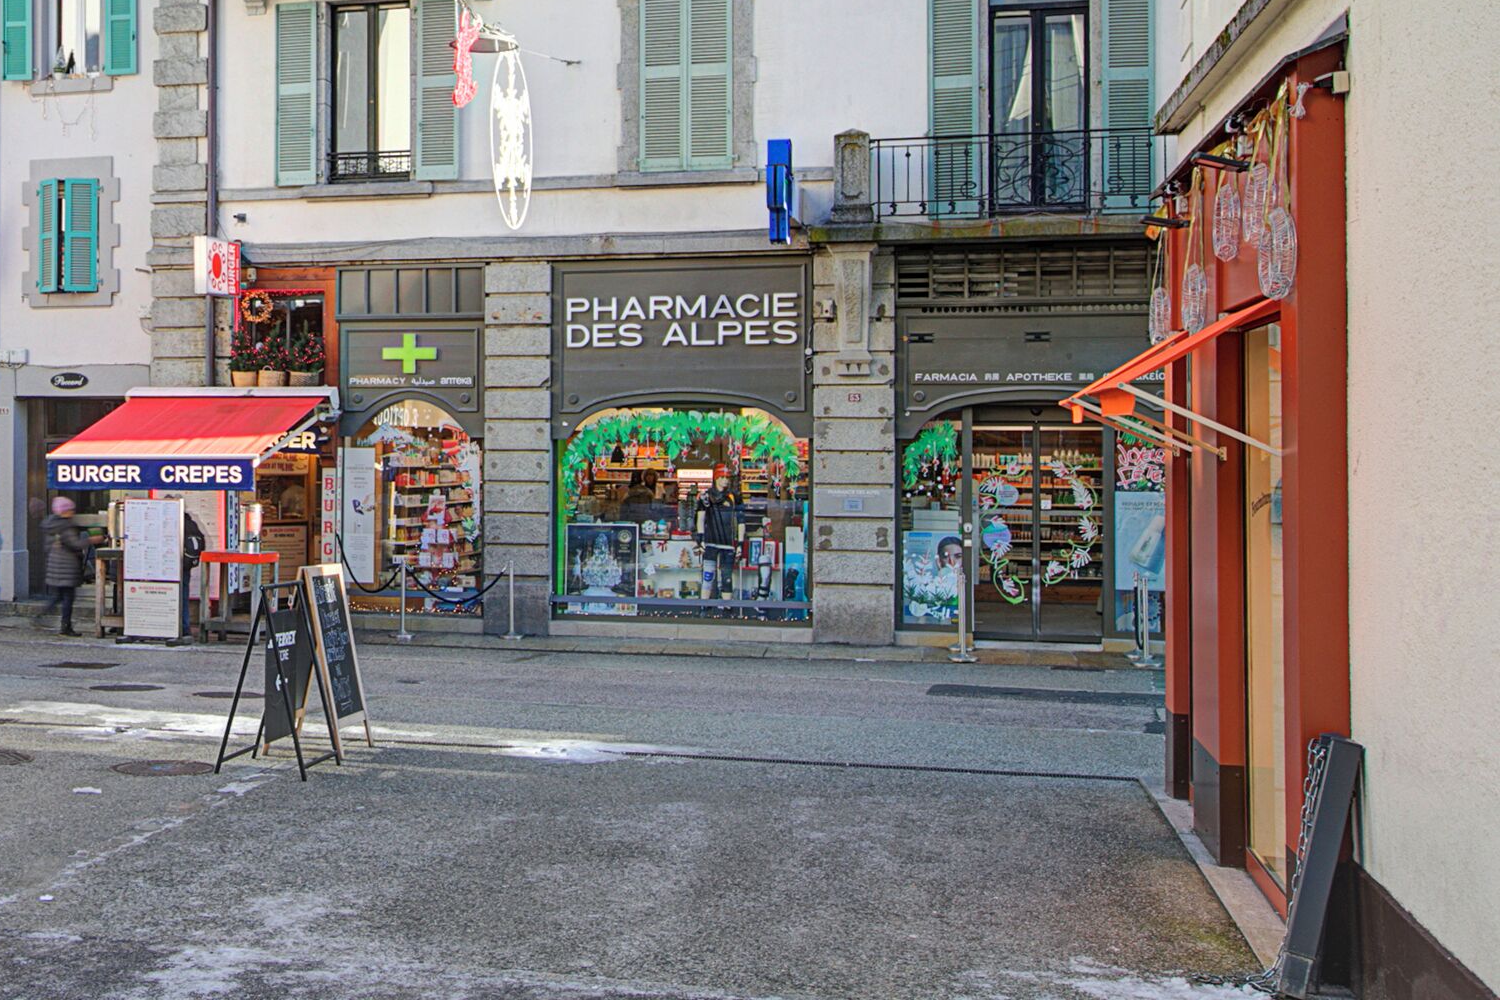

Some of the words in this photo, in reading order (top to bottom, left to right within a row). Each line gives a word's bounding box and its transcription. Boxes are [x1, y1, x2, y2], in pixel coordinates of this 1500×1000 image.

[566, 292, 799, 322] PHARMACIE
[566, 323, 643, 348] DES
[662, 320, 798, 346] ALPES
[349, 377, 406, 385] PHARMACY
[914, 372, 978, 381] FARMACIA
[1006, 372, 1073, 381] APOTHEKE
[57, 464, 141, 482] BURGER
[160, 464, 242, 483] CREPES
